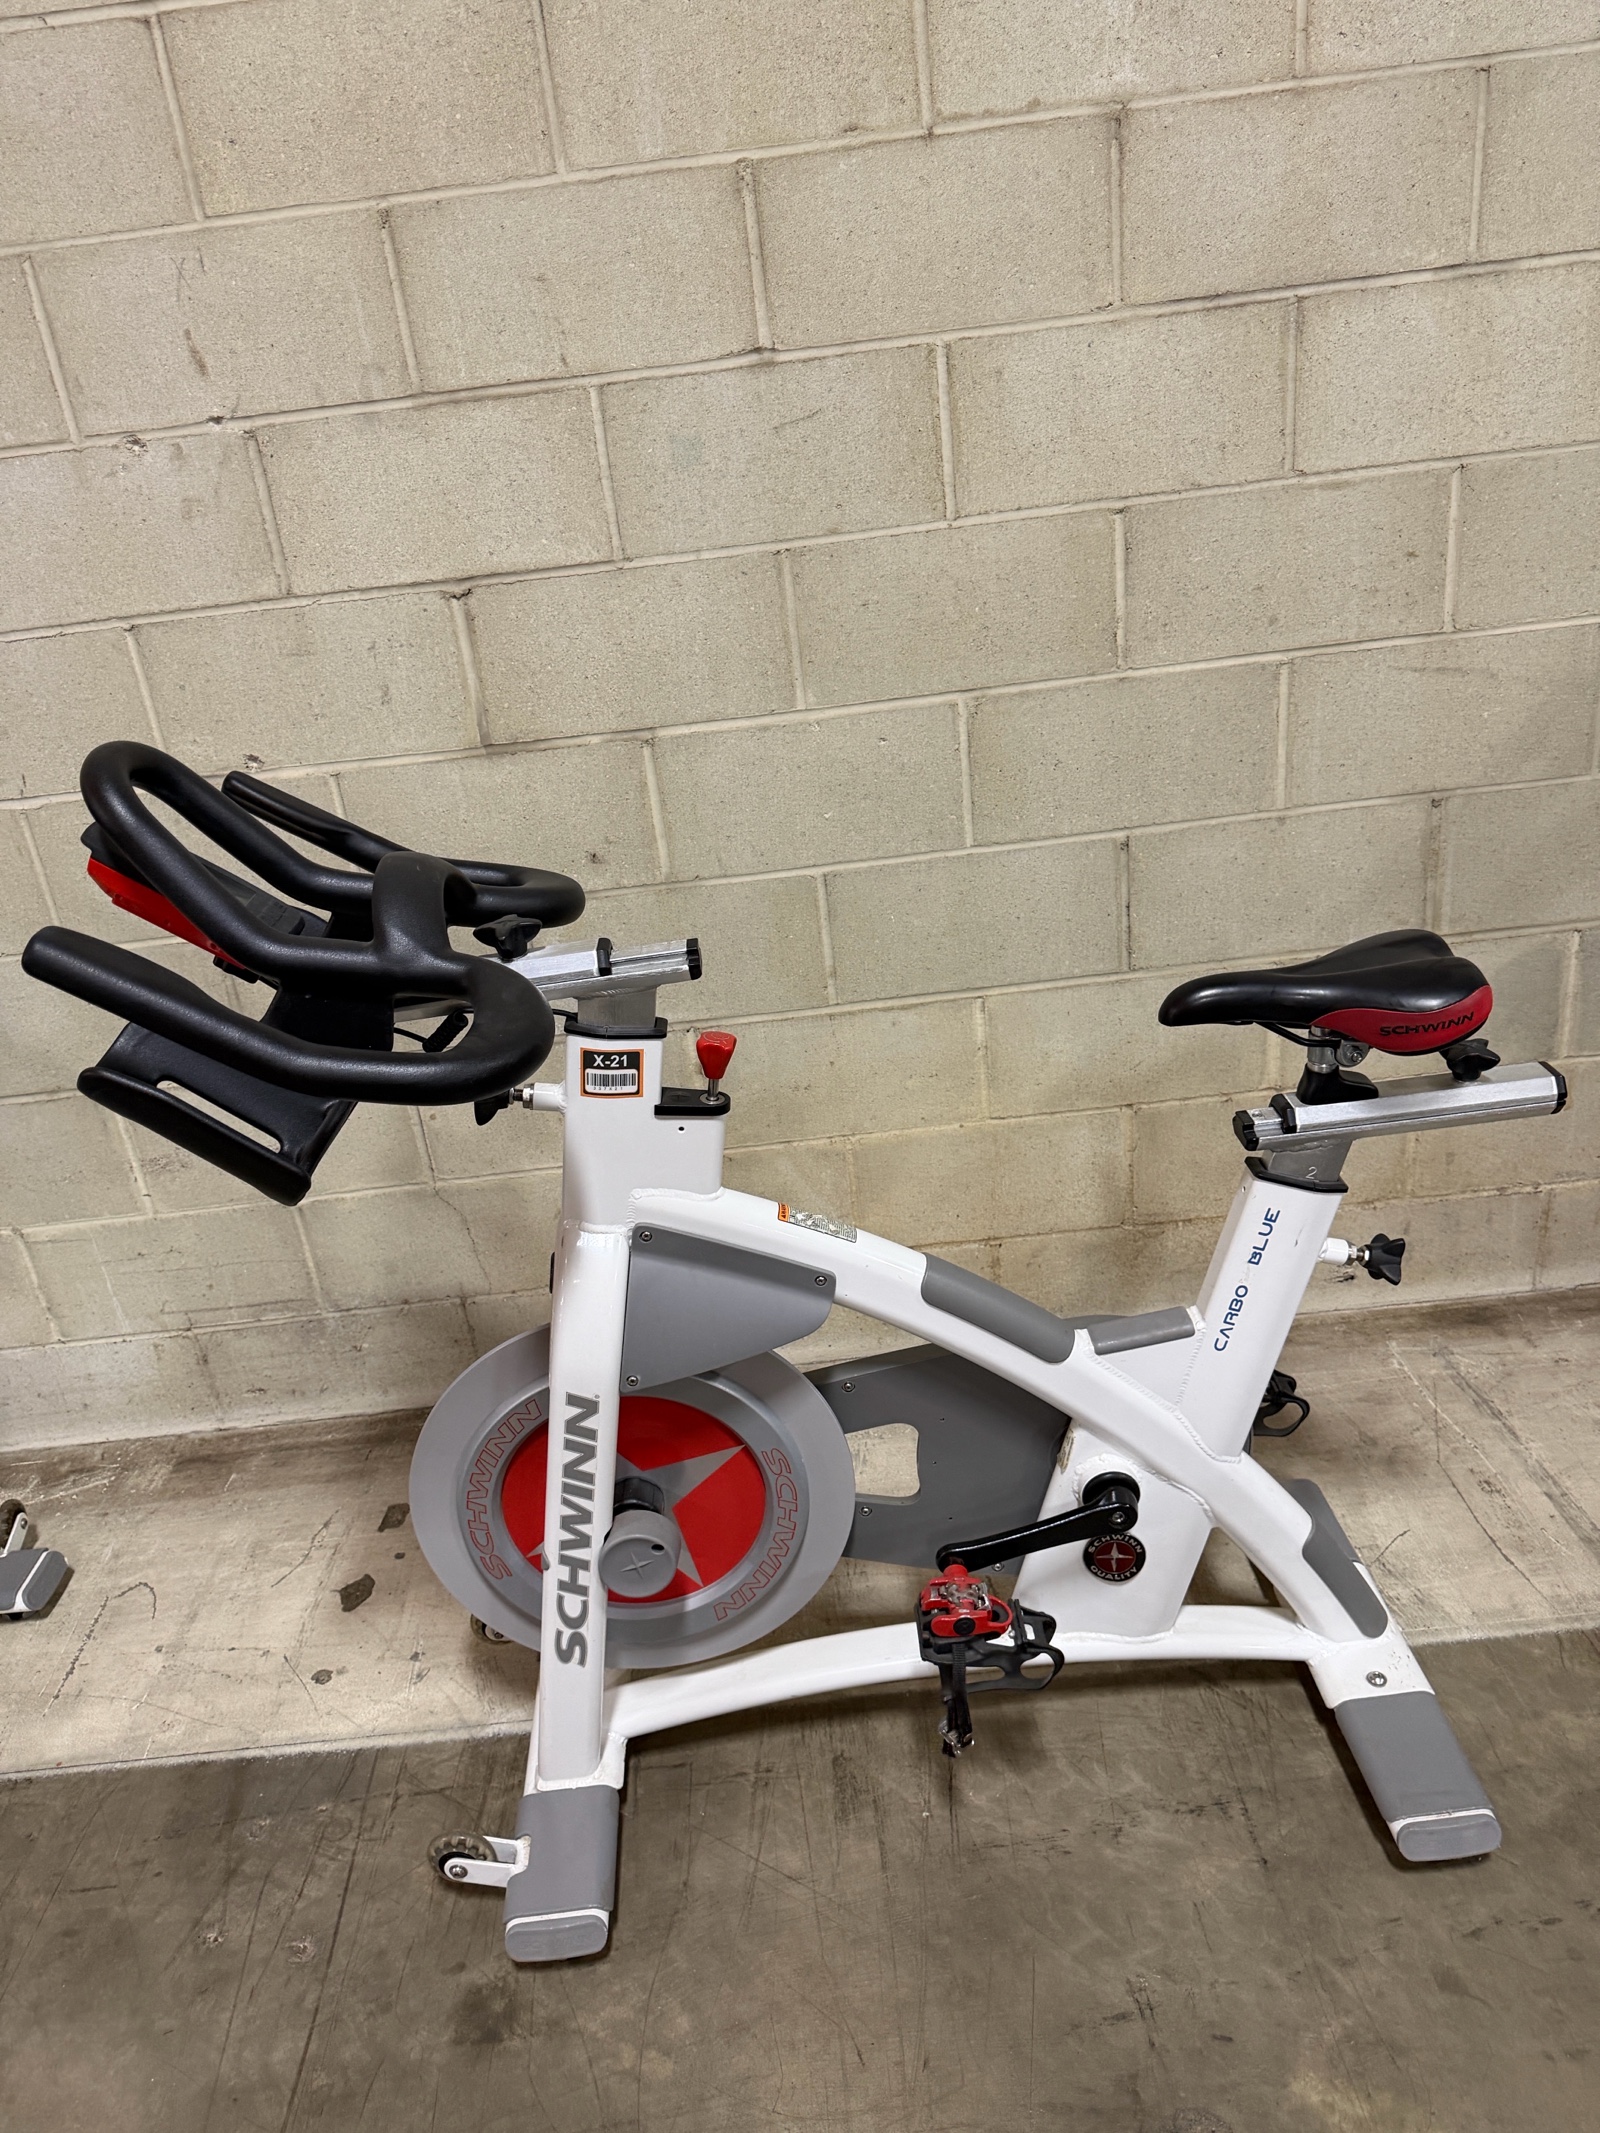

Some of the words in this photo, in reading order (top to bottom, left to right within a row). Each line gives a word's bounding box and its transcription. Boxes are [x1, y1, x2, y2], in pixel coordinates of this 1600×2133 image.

[1380, 1011, 1474, 1036] SCHWINN
[593, 1054, 628, 1068] X-21
[1305, 1166, 1318, 1180] 2
[1213, 1284, 1248, 1352] CARBO
[1247, 1207, 1281, 1266] BLUE
[466, 1399, 543, 1581] SCHWINN
[554, 1391, 600, 1668] SCHWINN
[713, 1448, 799, 1621] SCHWINN
[1088, 1534, 1143, 1553] SCHWINN
[1090, 1565, 1138, 1580] QUALITY
